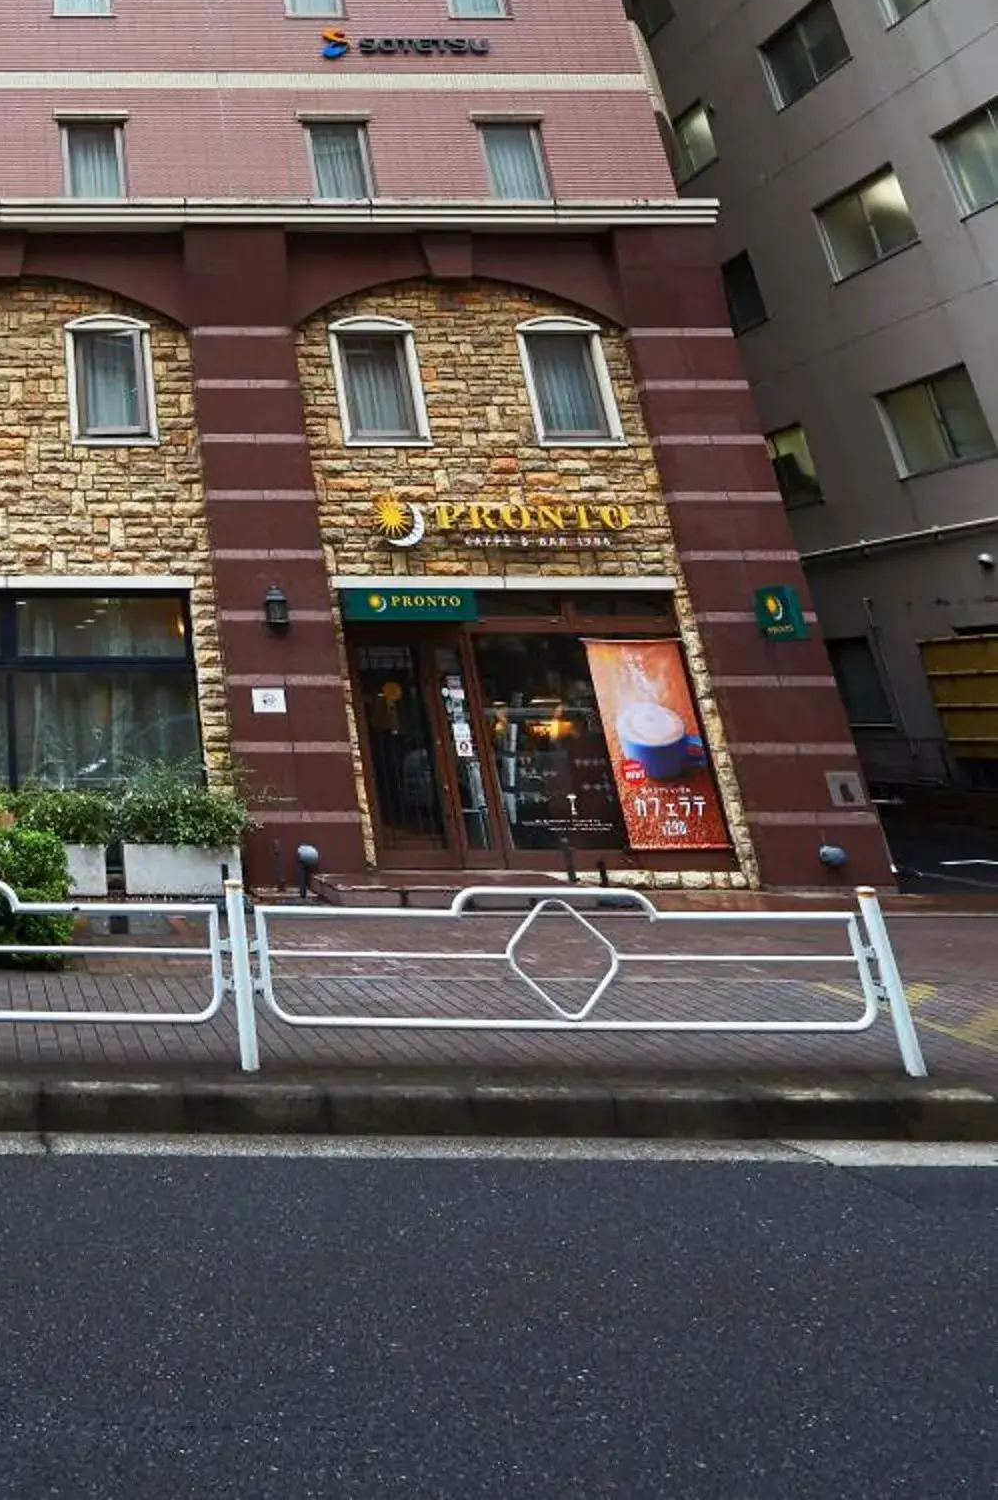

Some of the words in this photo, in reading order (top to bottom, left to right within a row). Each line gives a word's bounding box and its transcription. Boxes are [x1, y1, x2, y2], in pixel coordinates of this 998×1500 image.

[435, 501, 632, 530] PRONTO
[391, 595, 461, 608] PRONTO
[634, 795, 707, 818] カフェラテ
